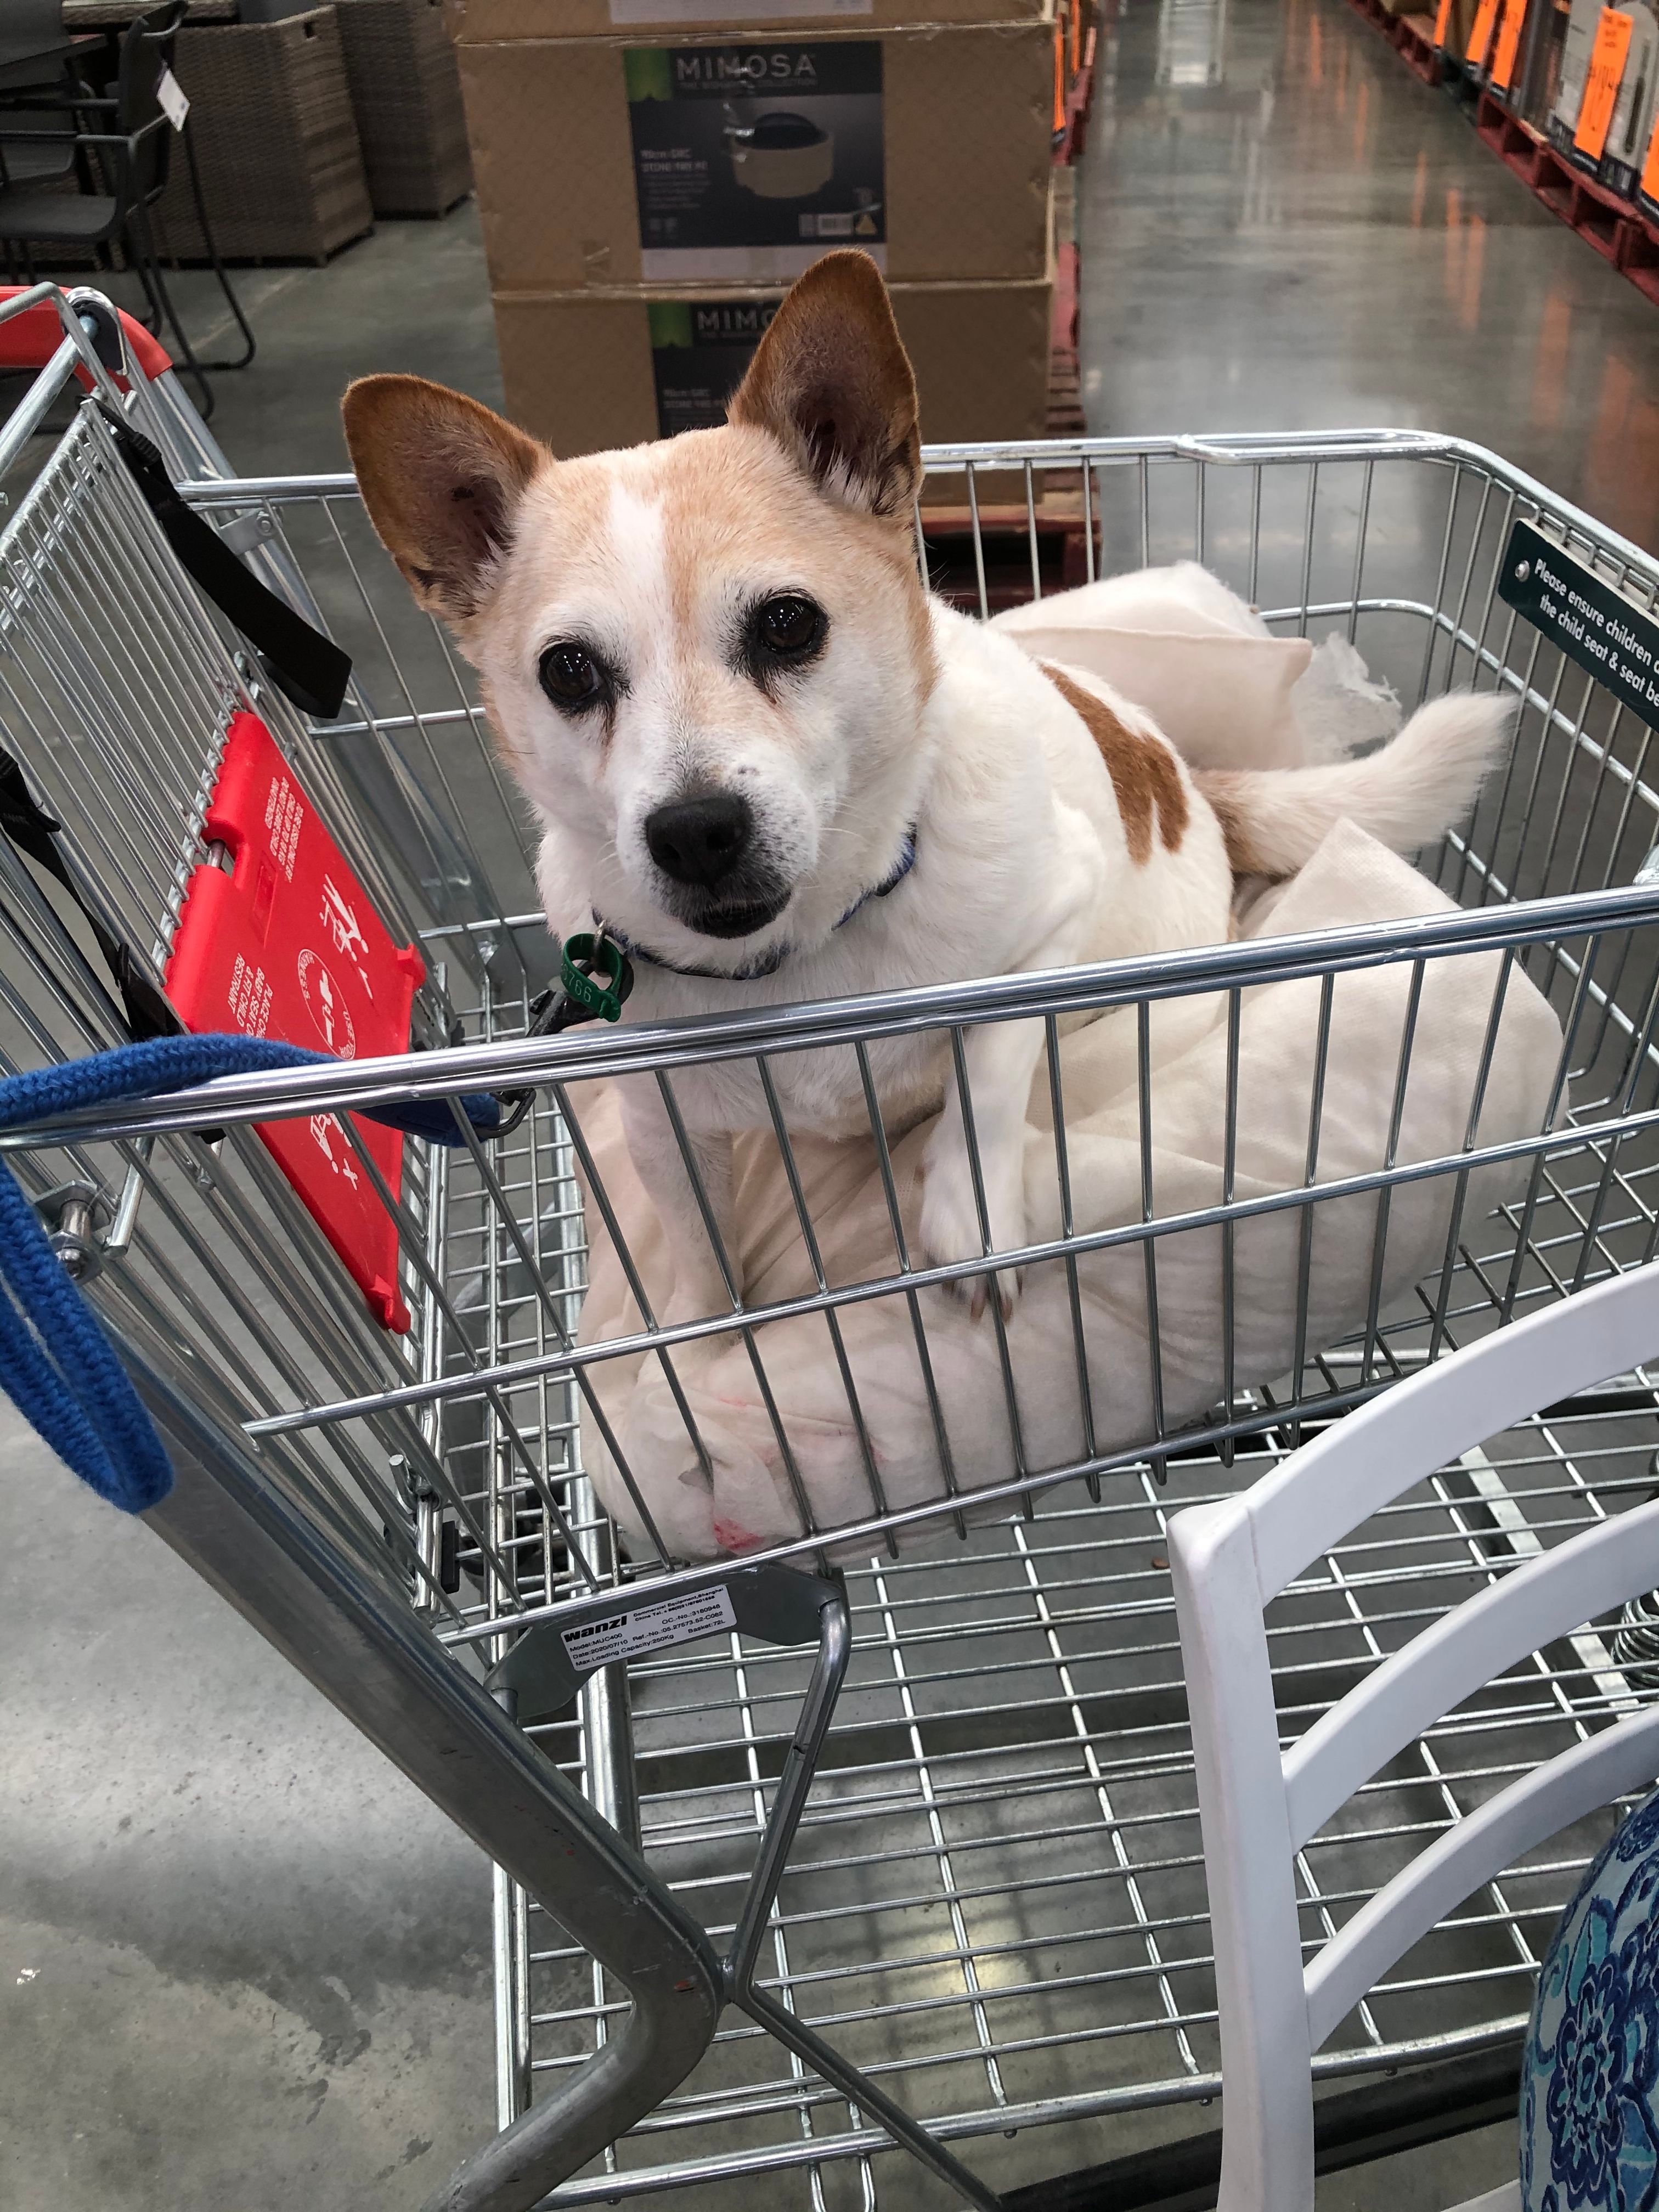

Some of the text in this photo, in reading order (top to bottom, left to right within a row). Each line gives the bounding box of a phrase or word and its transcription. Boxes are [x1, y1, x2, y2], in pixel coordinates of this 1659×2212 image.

[676, 54, 817, 80] MIMOSA
[1534, 558, 1652, 666] Please ensure children
[1539, 594, 1558, 619] the
[1558, 611, 1585, 641] child
[1583, 635, 1609, 661] seat
[1609, 652, 1619, 672] &
[1619, 664, 1646, 692] seat
[228, 953, 245, 1014] RESTRAINT
[236, 966, 254, 1027] & FIT CHILD
[253, 967, 265, 1001] BABY
[249, 996, 259, 1028] SEAT
[260, 983, 273, 1023] PLACE
[343, 1011, 354, 1040] USE
[633, 1605, 666, 1617] Commercial
[563, 1615, 627, 1643] wanzl
[570, 1633, 623, 1652] Model:MUC400
[621, 1634, 674, 1653] Capacity:250Kg
[687, 1620, 725, 1633] Basket:72L
[573, 1639, 628, 1659] Date:2020/07/10
